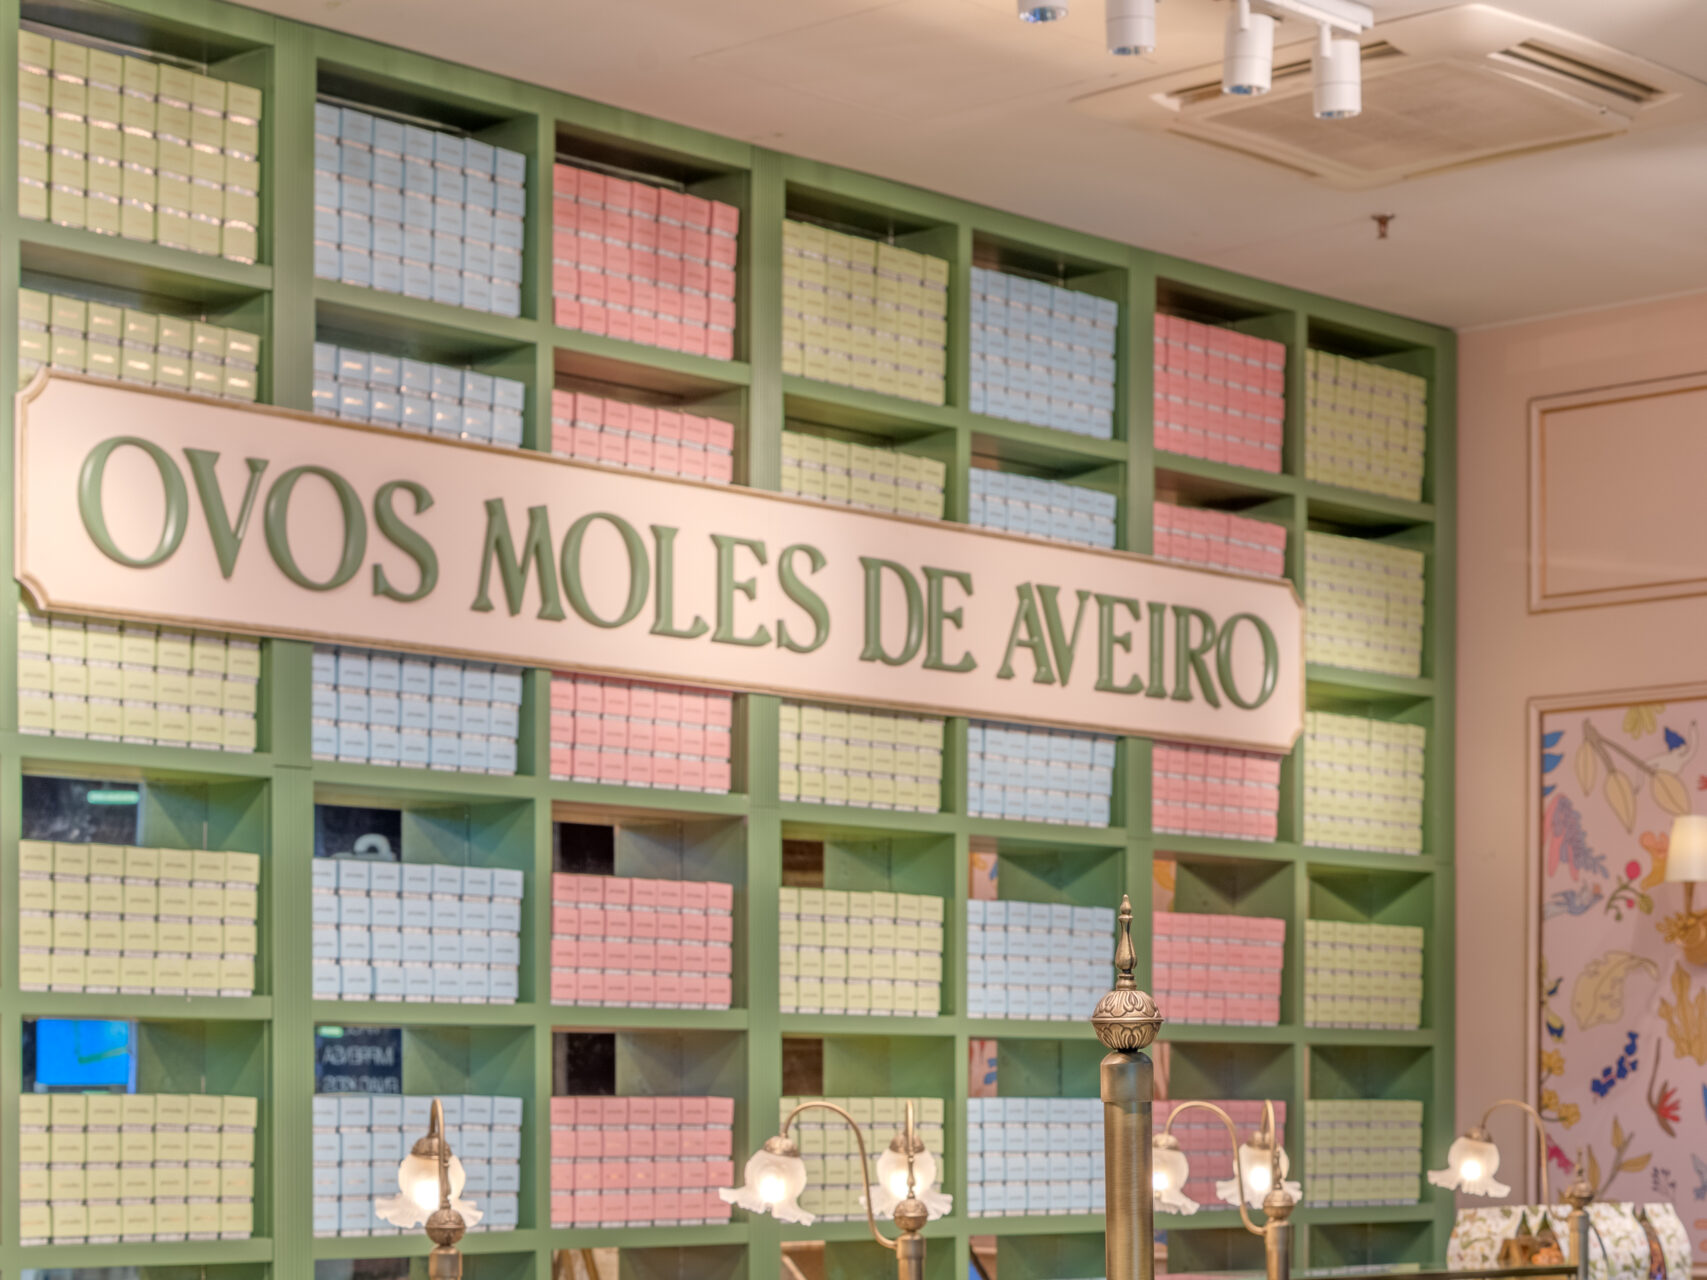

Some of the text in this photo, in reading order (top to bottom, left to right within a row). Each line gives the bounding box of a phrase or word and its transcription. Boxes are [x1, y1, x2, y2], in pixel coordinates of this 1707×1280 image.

[77, 435, 1279, 711] OVOS MOLES DE AVEIRO
